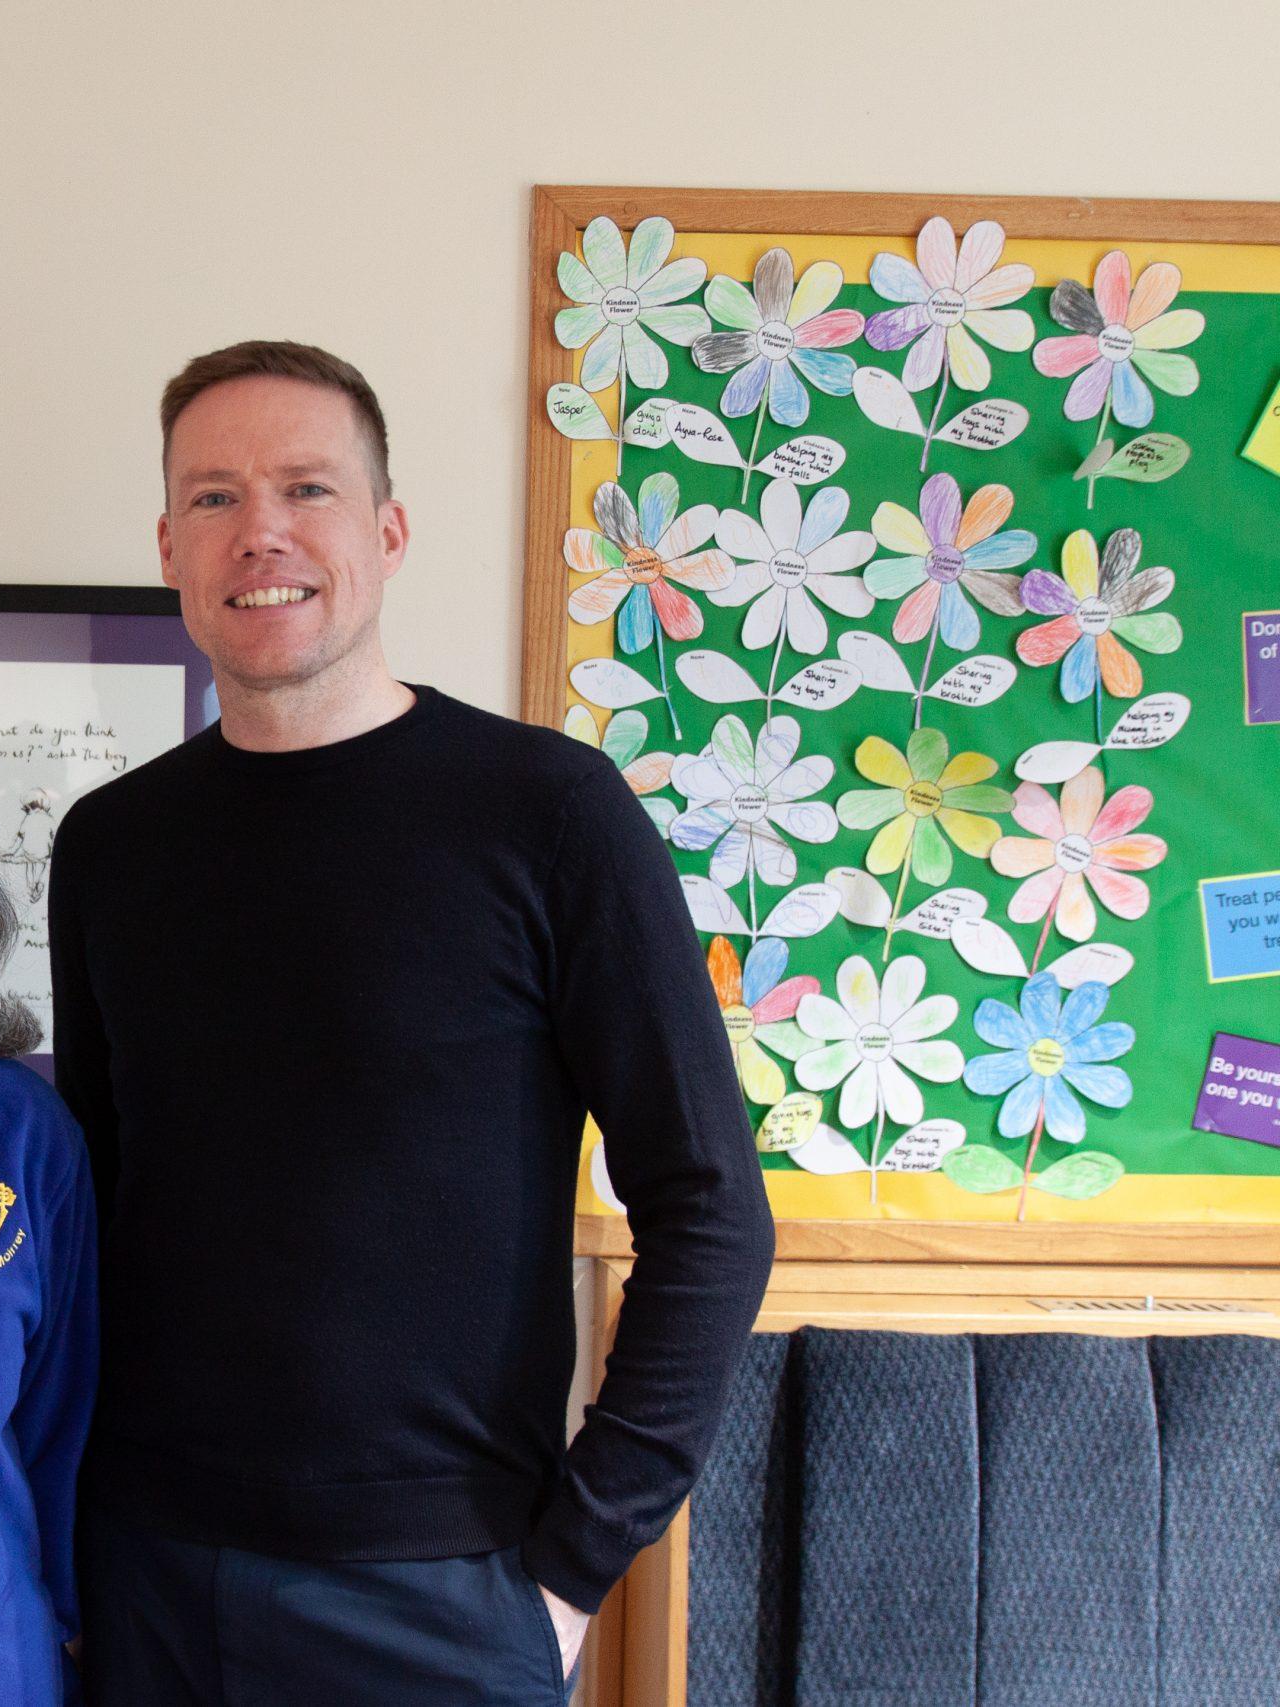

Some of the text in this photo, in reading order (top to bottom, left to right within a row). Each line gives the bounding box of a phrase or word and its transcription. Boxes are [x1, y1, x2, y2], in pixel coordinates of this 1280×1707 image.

[761, 331, 792, 342] Kindness
[763, 338, 787, 349] Flower
[554, 400, 587, 420] Jasper
[971, 408, 1005, 426] Sharing
[967, 432, 1000, 446] brother
[786, 440, 816, 463] helping
[774, 450, 830, 475] brother when
[774, 463, 785, 473] he
[626, 557, 657, 566] Kindness
[632, 566, 655, 574] Flower
[773, 560, 805, 570] Kindness
[776, 568, 800, 576] Flower
[1261, 643, 1278, 659] of
[804, 669, 836, 689] Sharing
[955, 666, 992, 686] Sharing
[940, 687, 978, 704] brother
[29, 723, 43, 735] do
[51, 727, 78, 746] you
[47, 748, 77, 760] asked
[105, 748, 127, 771] boy
[1216, 890, 1259, 908] Treat
[1228, 916, 1260, 933] you
[1210, 1056, 1234, 1076] Be
[1206, 1082, 1238, 1100] one
[1239, 1090, 1273, 1108] you
